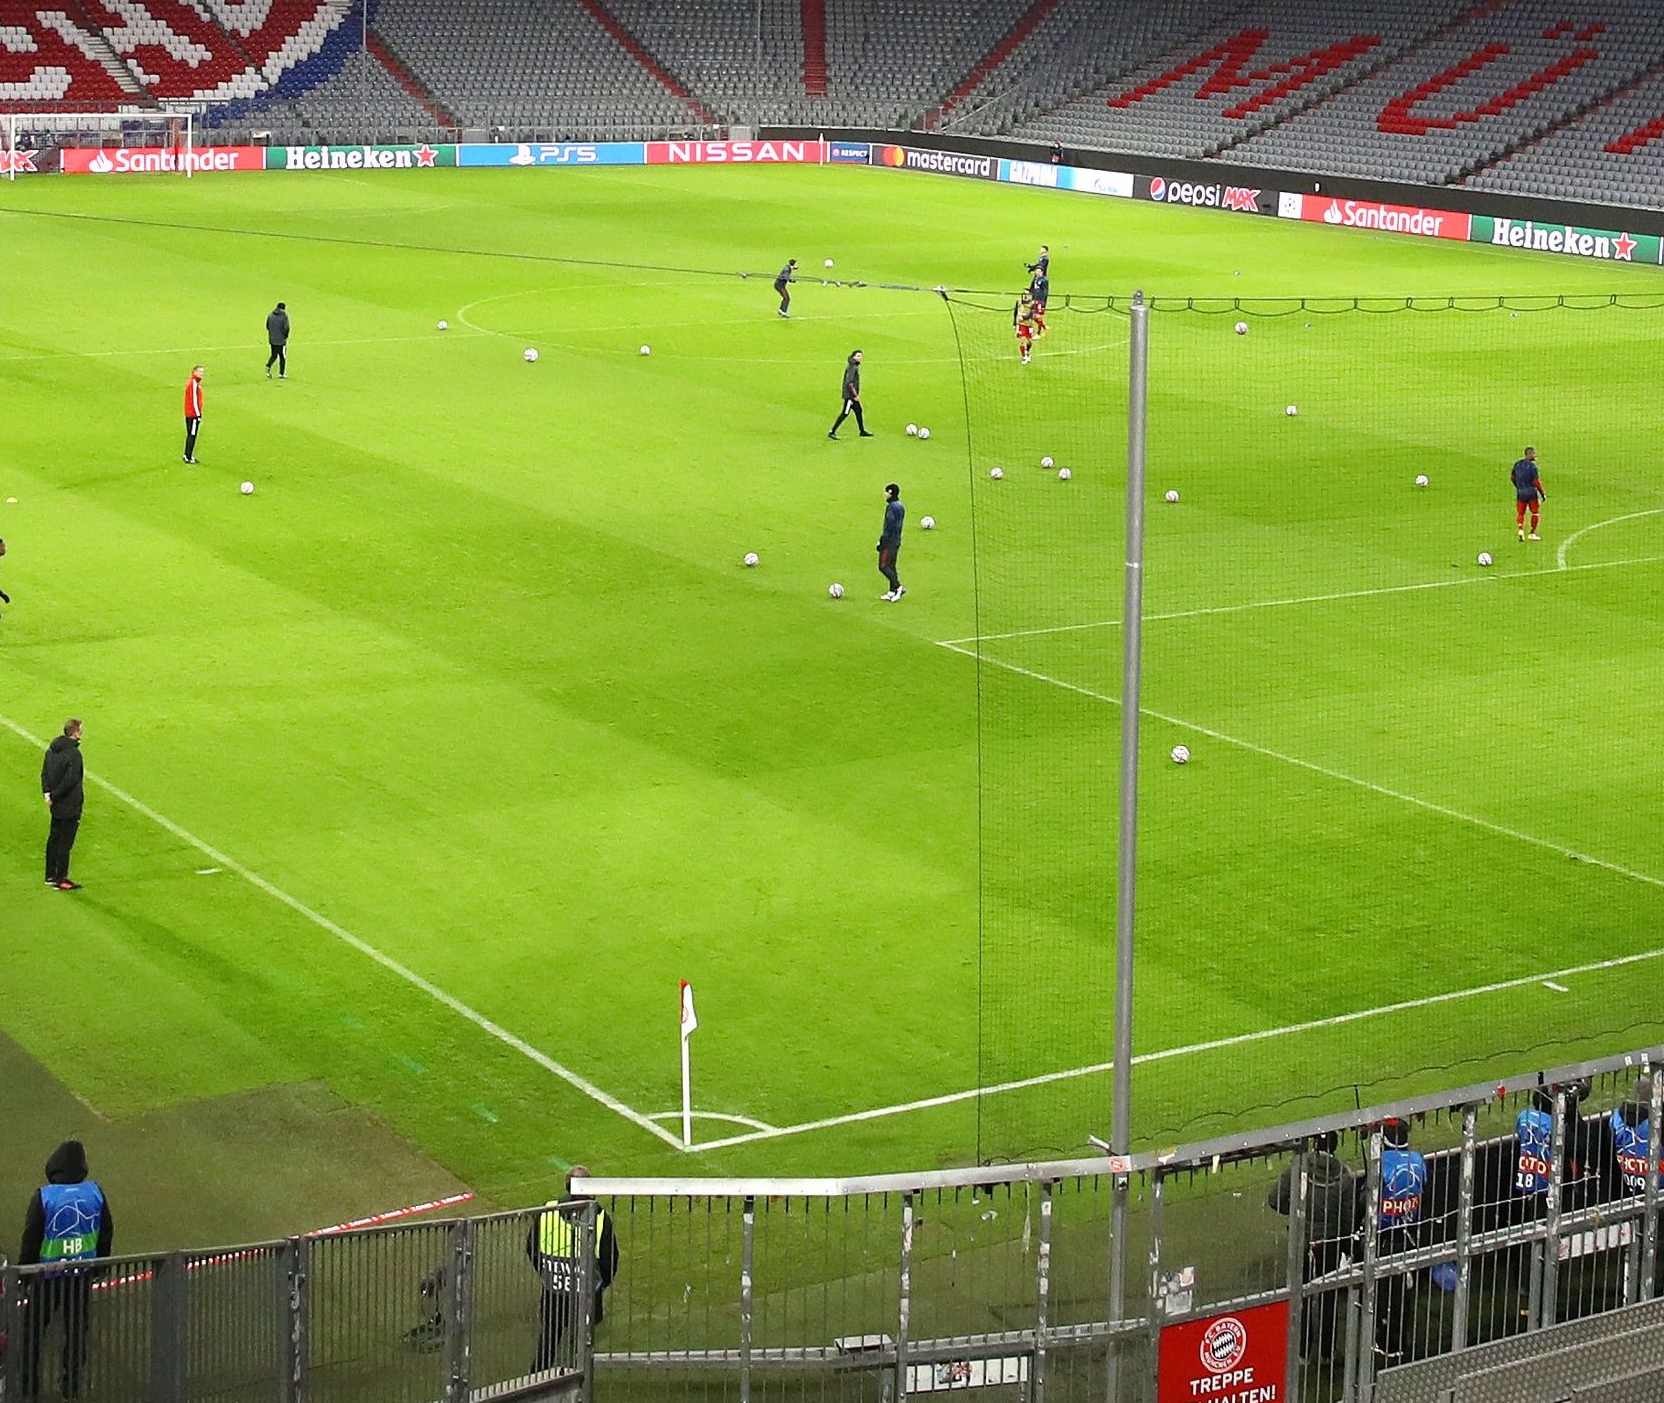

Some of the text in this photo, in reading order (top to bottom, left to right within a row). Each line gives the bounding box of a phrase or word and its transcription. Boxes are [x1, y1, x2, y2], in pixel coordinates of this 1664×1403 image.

[115, 148, 239, 173] Santander
[286, 147, 412, 170] Heineken
[539, 145, 598, 164] PS5
[668, 142, 805, 162] NISSAN
[907, 149, 991, 177] mastercard
[1168, 181, 1262, 212] pepsi MAX
[1344, 200, 1443, 237] Santander
[1492, 217, 1610, 259] Heineken
[1382, 1198, 1419, 1214] PHOT
[62, 1237, 83, 1256] HB
[1189, 1367, 1255, 1396] TREPPE
